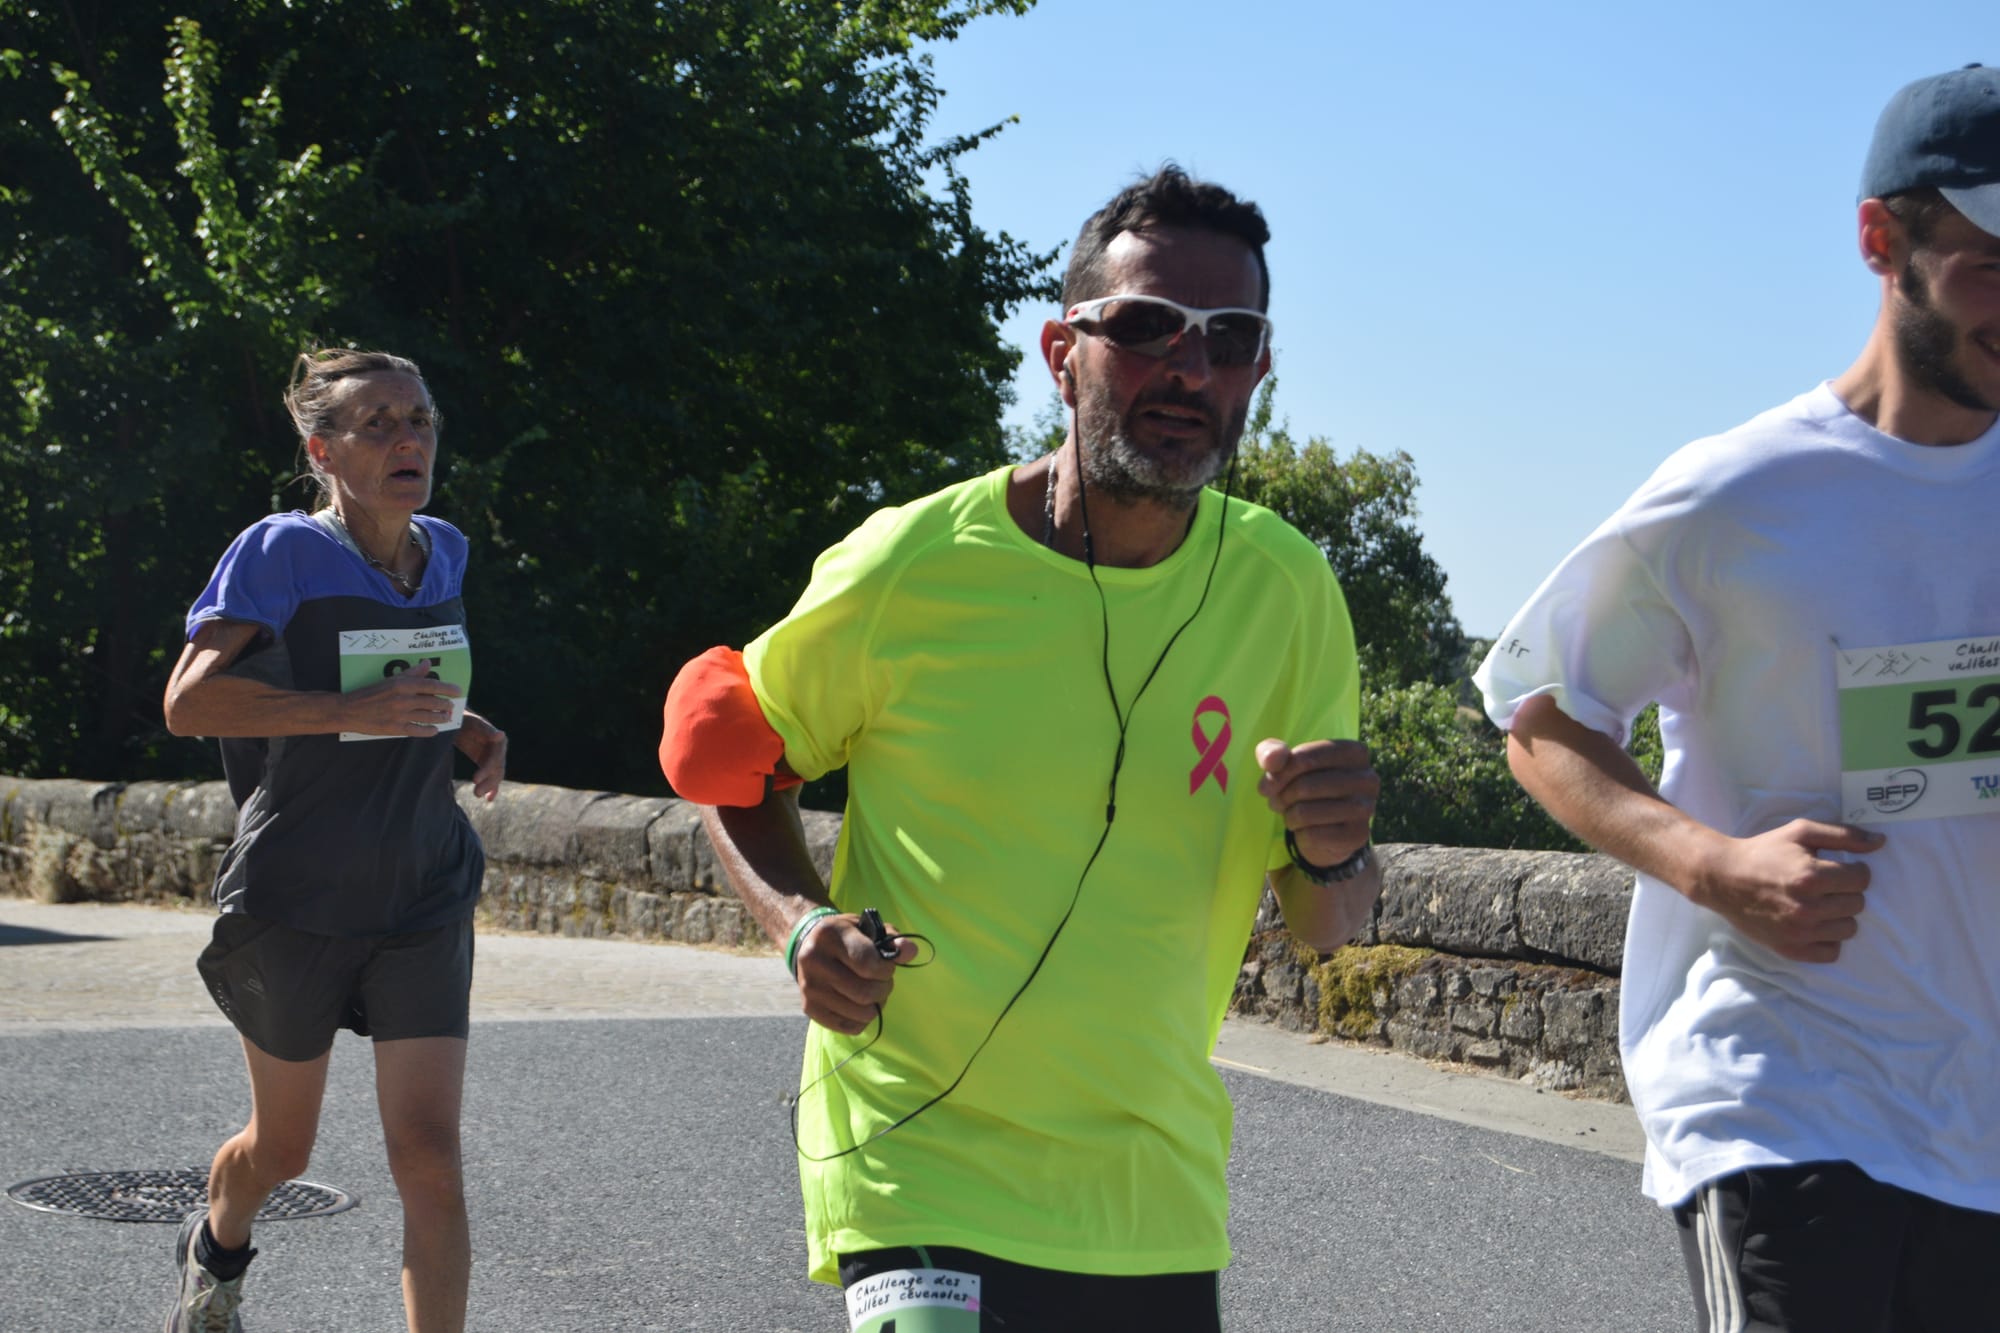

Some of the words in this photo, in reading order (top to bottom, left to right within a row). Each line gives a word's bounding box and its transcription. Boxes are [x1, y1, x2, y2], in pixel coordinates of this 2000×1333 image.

[1956, 641, 2000, 656] Chall
[1948, 656, 2000, 671] vallées
[1907, 683, 2000, 759] 52
[1970, 775, 2000, 790] TU
[1867, 784, 1919, 801] BFP
[1977, 786, 2000, 799] AV
[856, 1275, 923, 1301] Challenge
[933, 1275, 960, 1287] des
[900, 1289, 969, 1303] cévenoles
